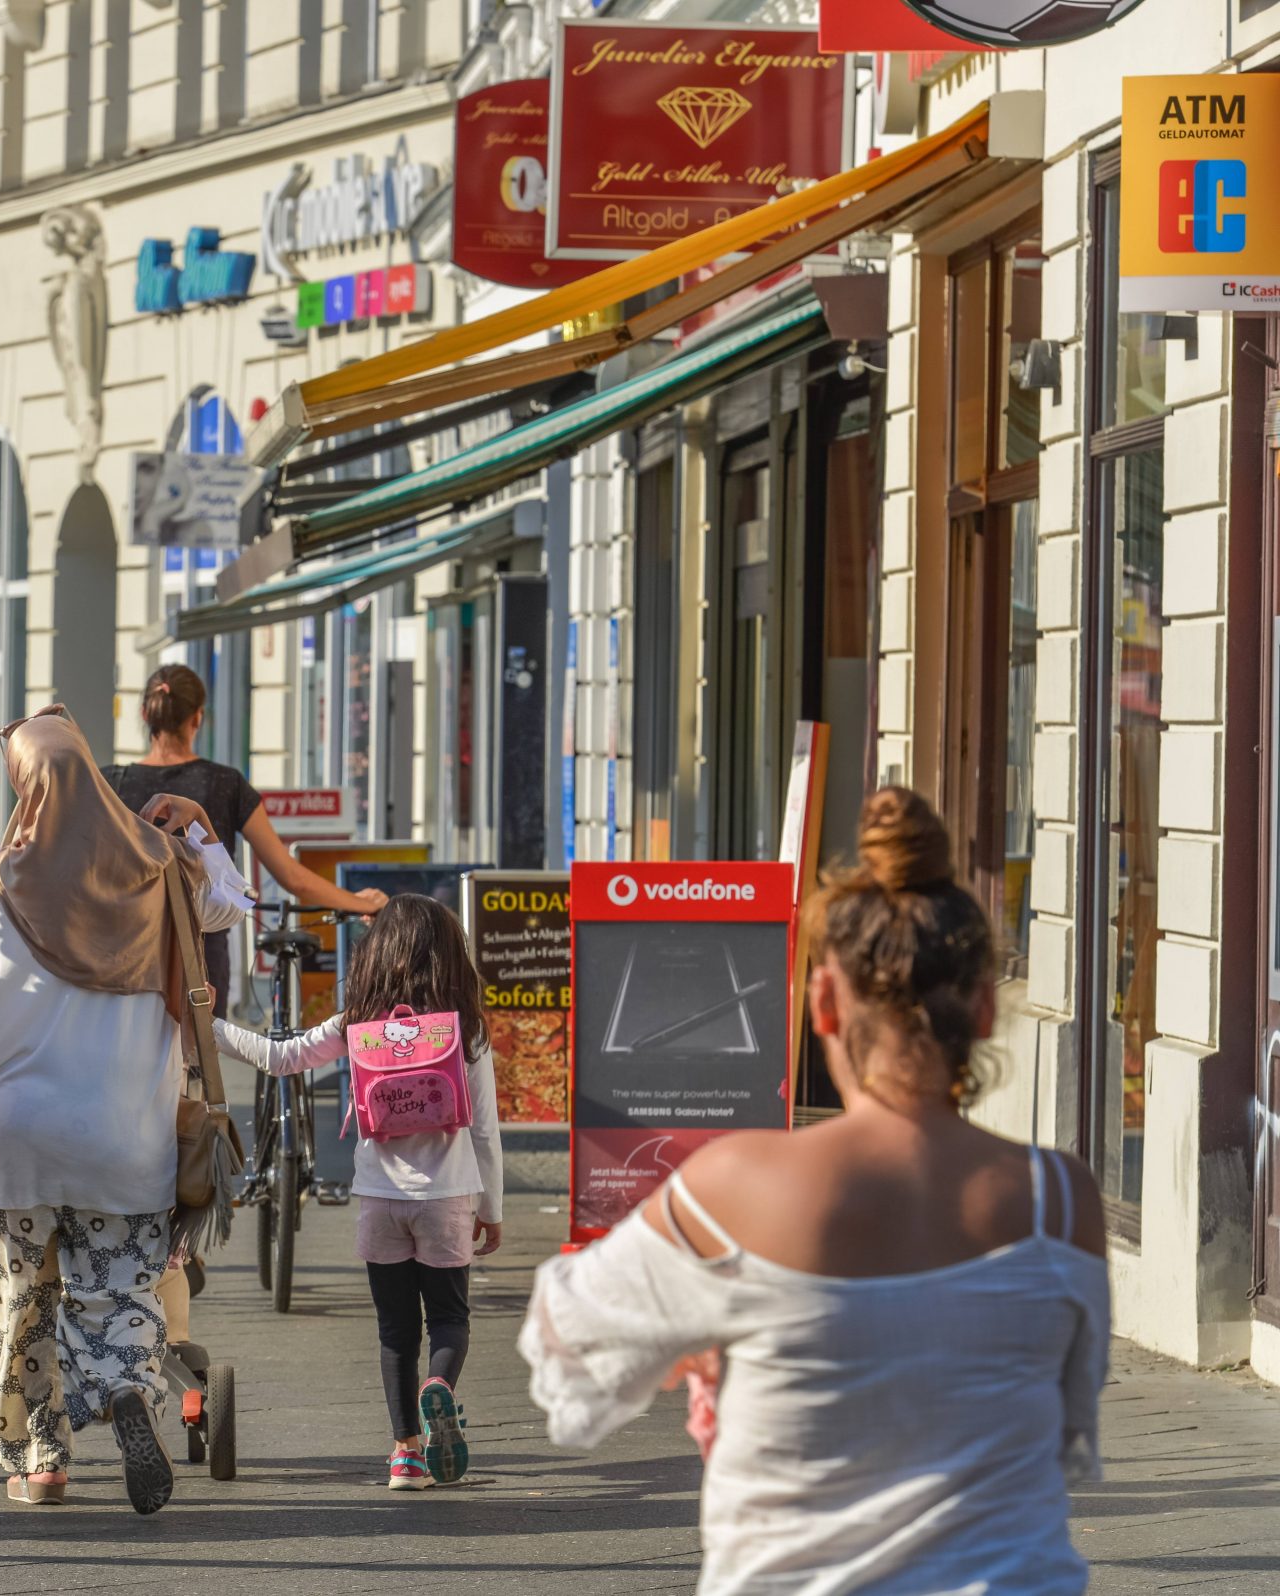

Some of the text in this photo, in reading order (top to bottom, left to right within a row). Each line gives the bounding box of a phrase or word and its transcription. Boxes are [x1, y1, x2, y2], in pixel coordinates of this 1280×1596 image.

[572, 39, 838, 85] Juwelier Elegance
[1159, 95, 1246, 125] ATM
[1159, 129, 1245, 139] GELDAUTOMAT
[591, 161, 654, 192] Gold
[664, 161, 730, 184] Silber
[603, 204, 689, 235] Altgold
[644, 878, 755, 900] vodafone
[485, 984, 555, 1007] Sofort
[375, 1088, 413, 1103] Hello
[612, 1089, 629, 1098] The
[654, 1091, 681, 1100] super
[683, 1089, 726, 1100] powerful
[388, 1100, 428, 1116] Kitty
[628, 1107, 672, 1116] SAMSUNG
[675, 1107, 706, 1118] Galaxy
